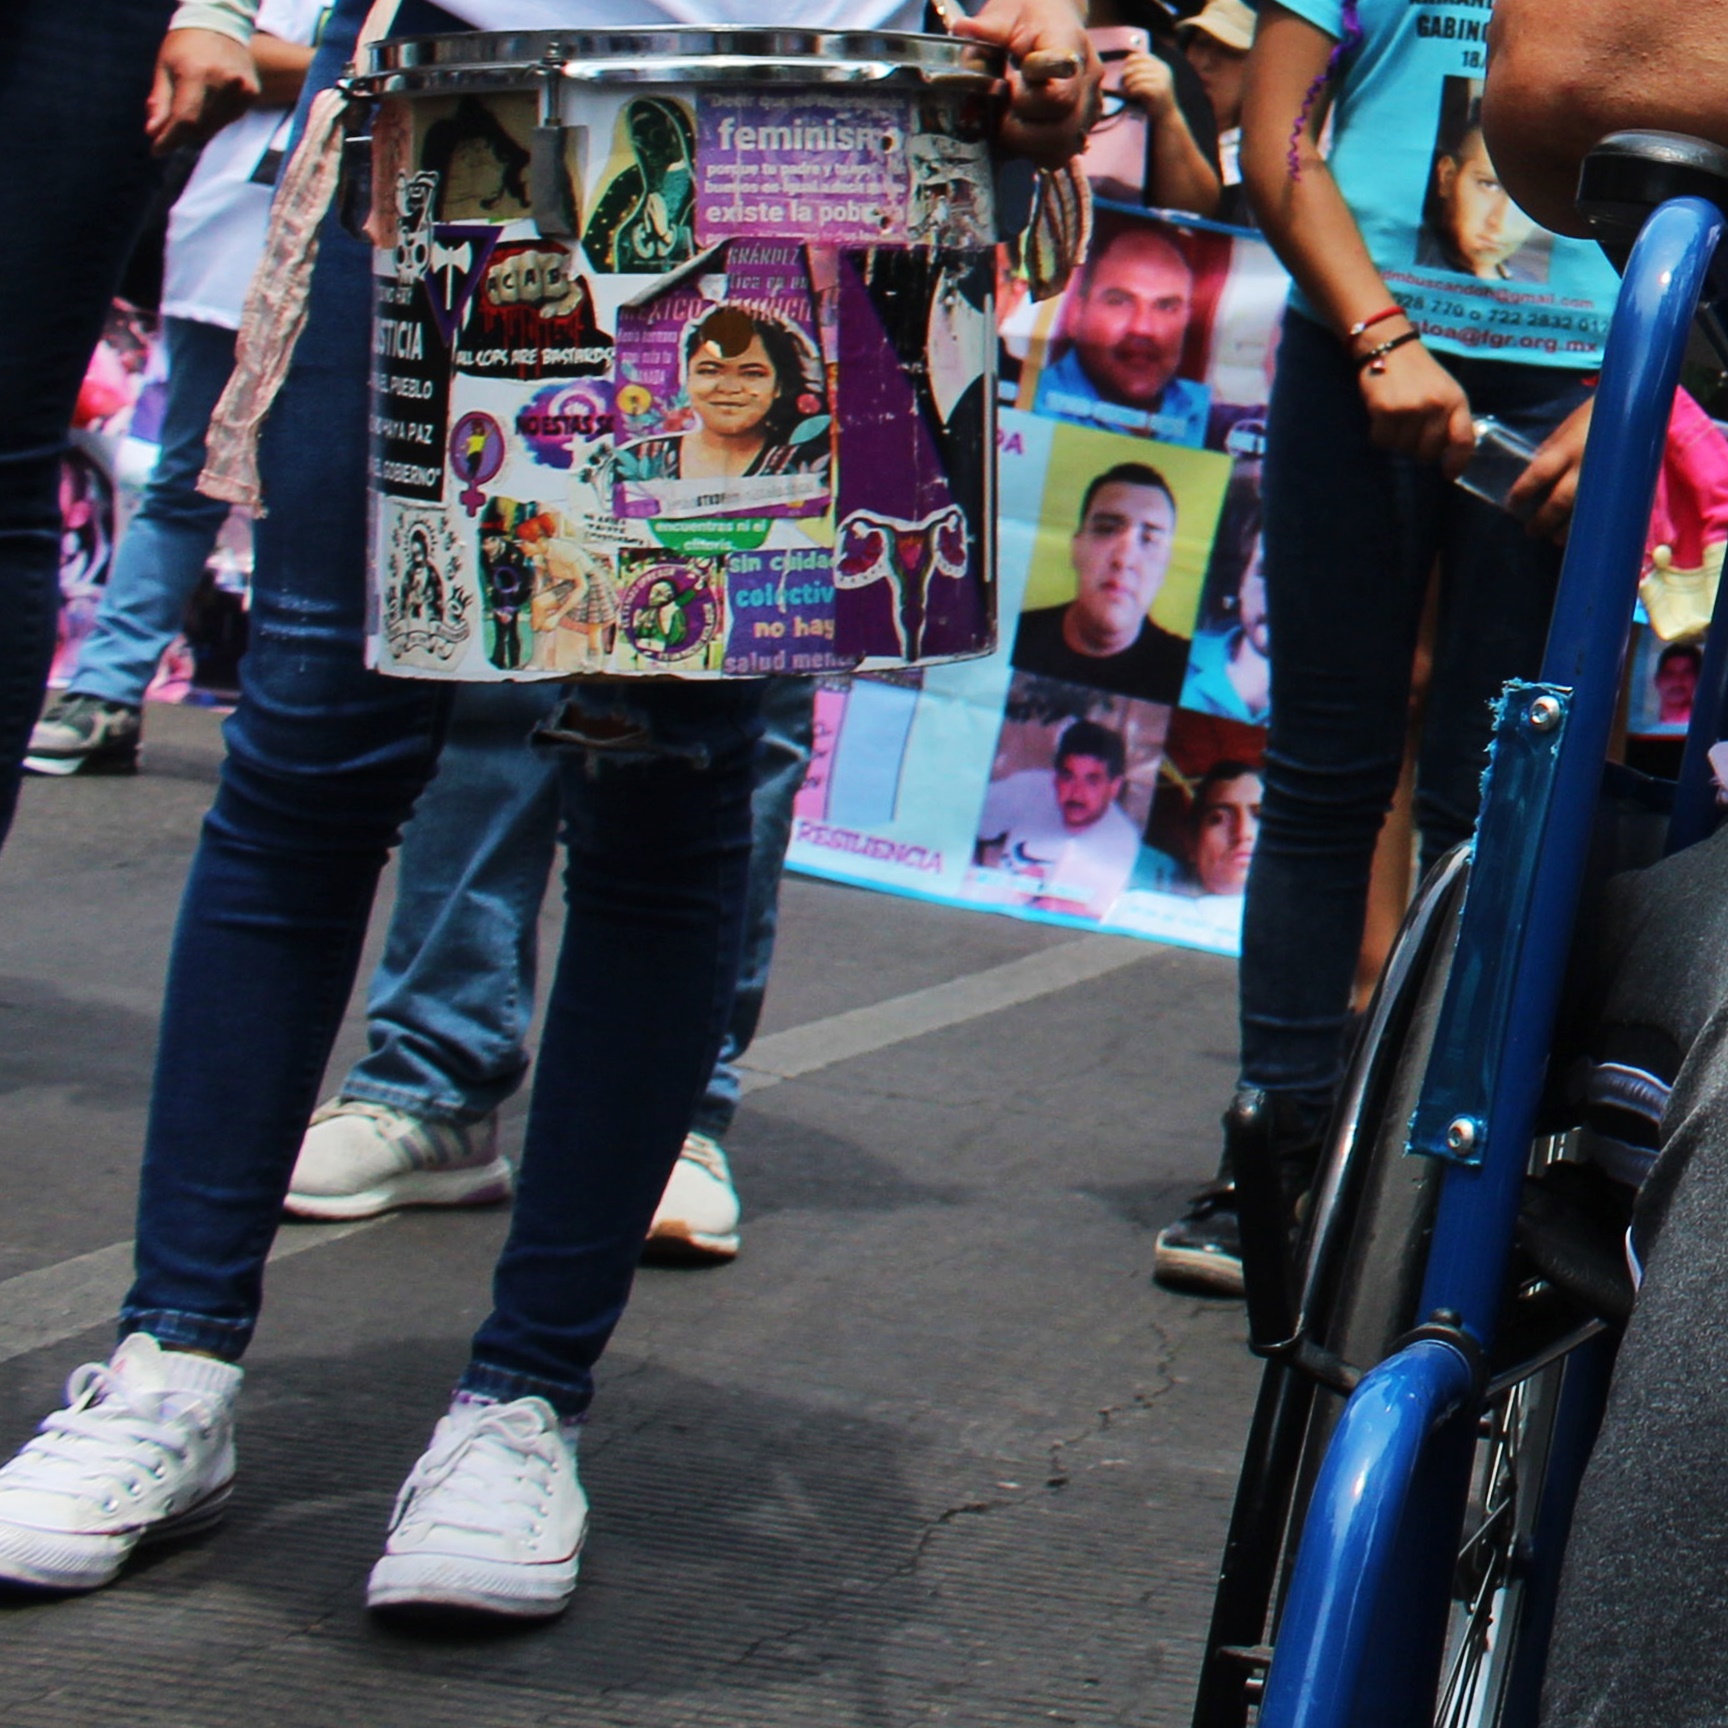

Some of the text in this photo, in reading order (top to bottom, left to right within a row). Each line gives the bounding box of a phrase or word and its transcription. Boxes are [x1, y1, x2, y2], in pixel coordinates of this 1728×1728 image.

[705, 201, 785, 223] existe
[790, 199, 812, 223] la
[1488, 309, 1522, 326] 722
[390, 375, 433, 399] PUEBLO
[408, 423, 434, 445] PAZ
[728, 551, 762, 573] sin
[753, 622, 785, 638] no
[724, 651, 786, 673] salud
